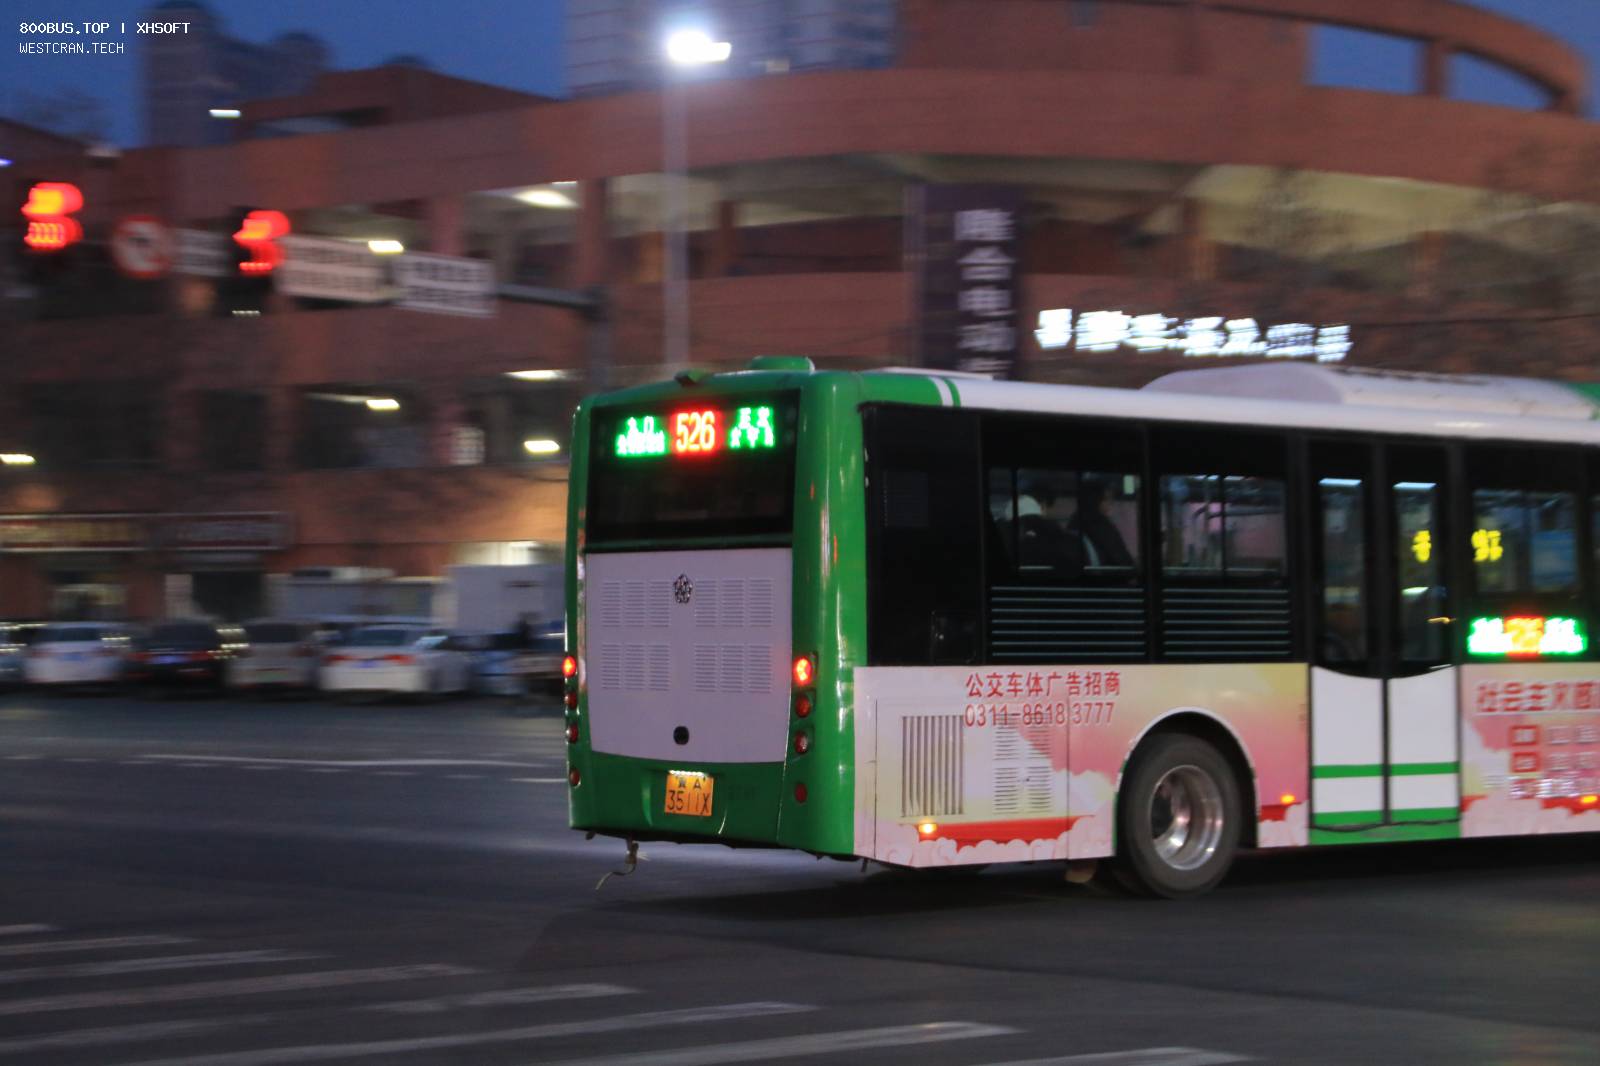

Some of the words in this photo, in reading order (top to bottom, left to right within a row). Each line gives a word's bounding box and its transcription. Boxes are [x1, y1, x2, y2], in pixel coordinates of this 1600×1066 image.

[675, 411, 716, 453] 526
[966, 671, 1121, 698] 公交车体广告招商
[666, 789, 711, 815] 3511X
